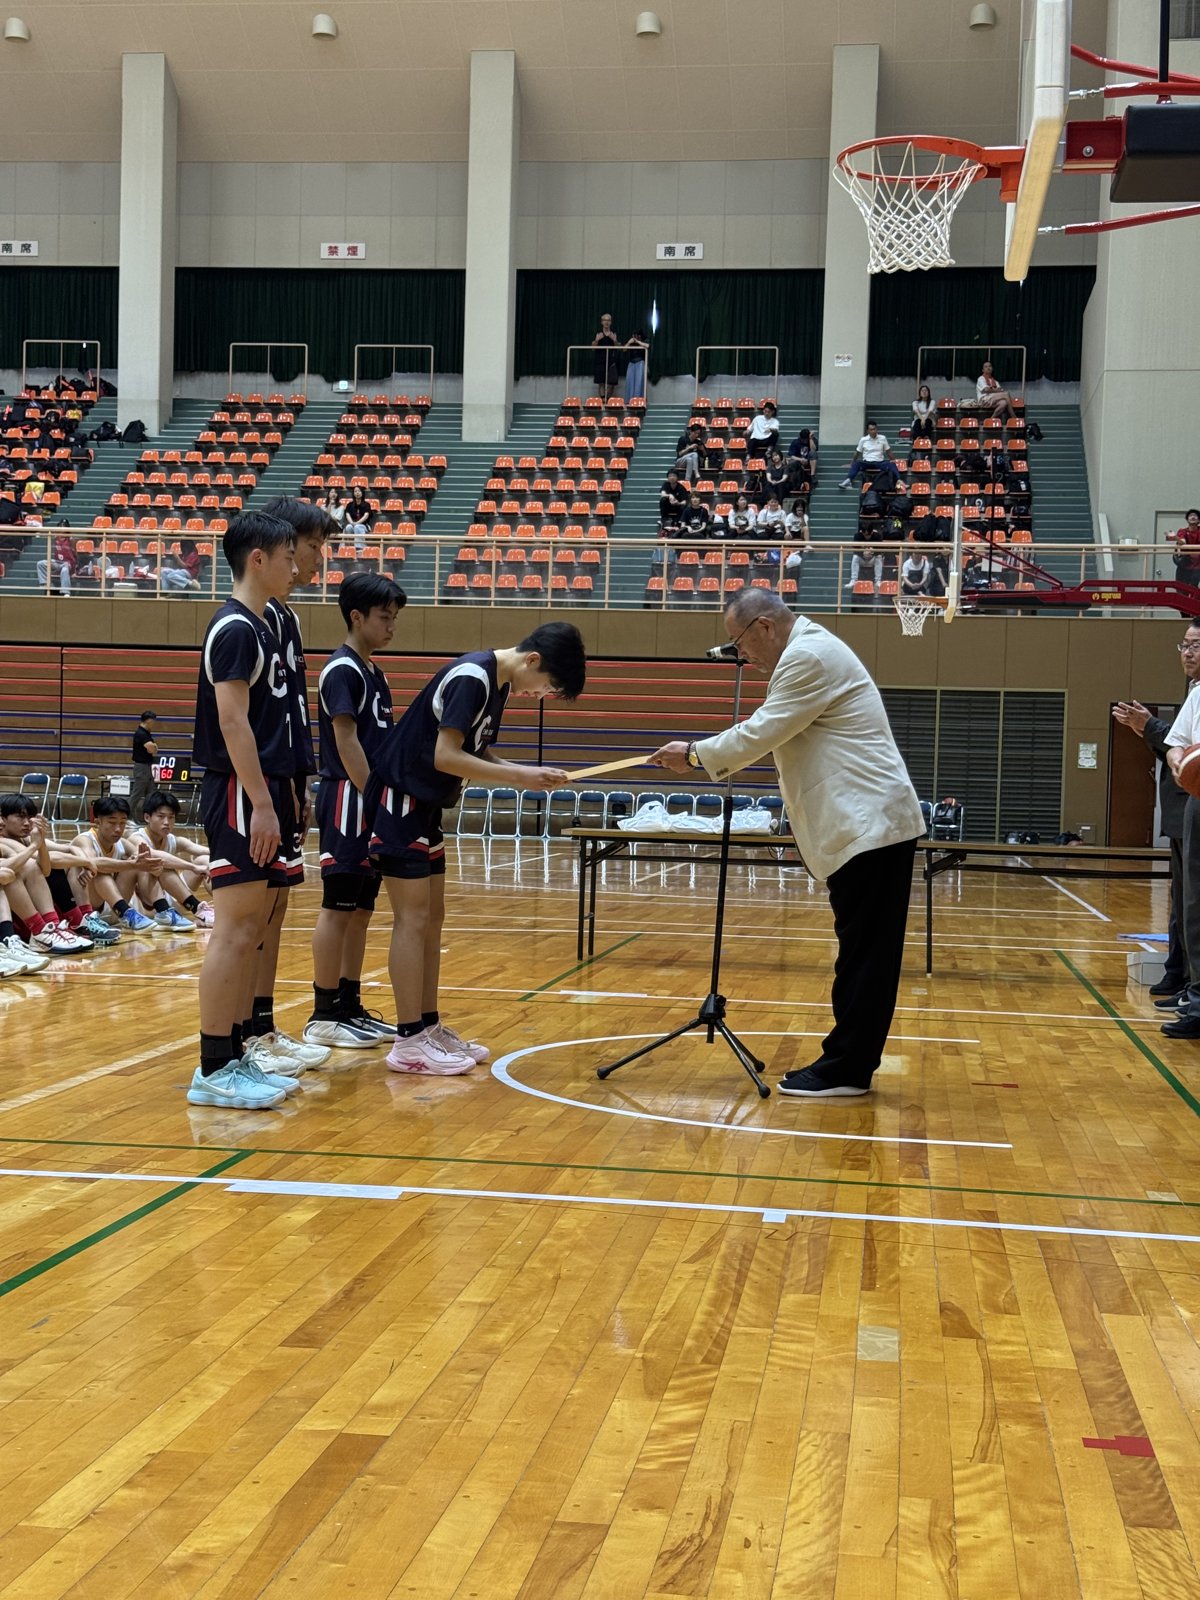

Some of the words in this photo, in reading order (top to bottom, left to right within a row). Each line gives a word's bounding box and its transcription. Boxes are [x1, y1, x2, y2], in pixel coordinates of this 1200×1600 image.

[1, 243, 32, 253] 南席
[328, 245, 359, 256] 禁煙
[664, 246, 696, 257] 南席
[161, 769, 173, 779] 60
[181, 770, 188, 781] 0
